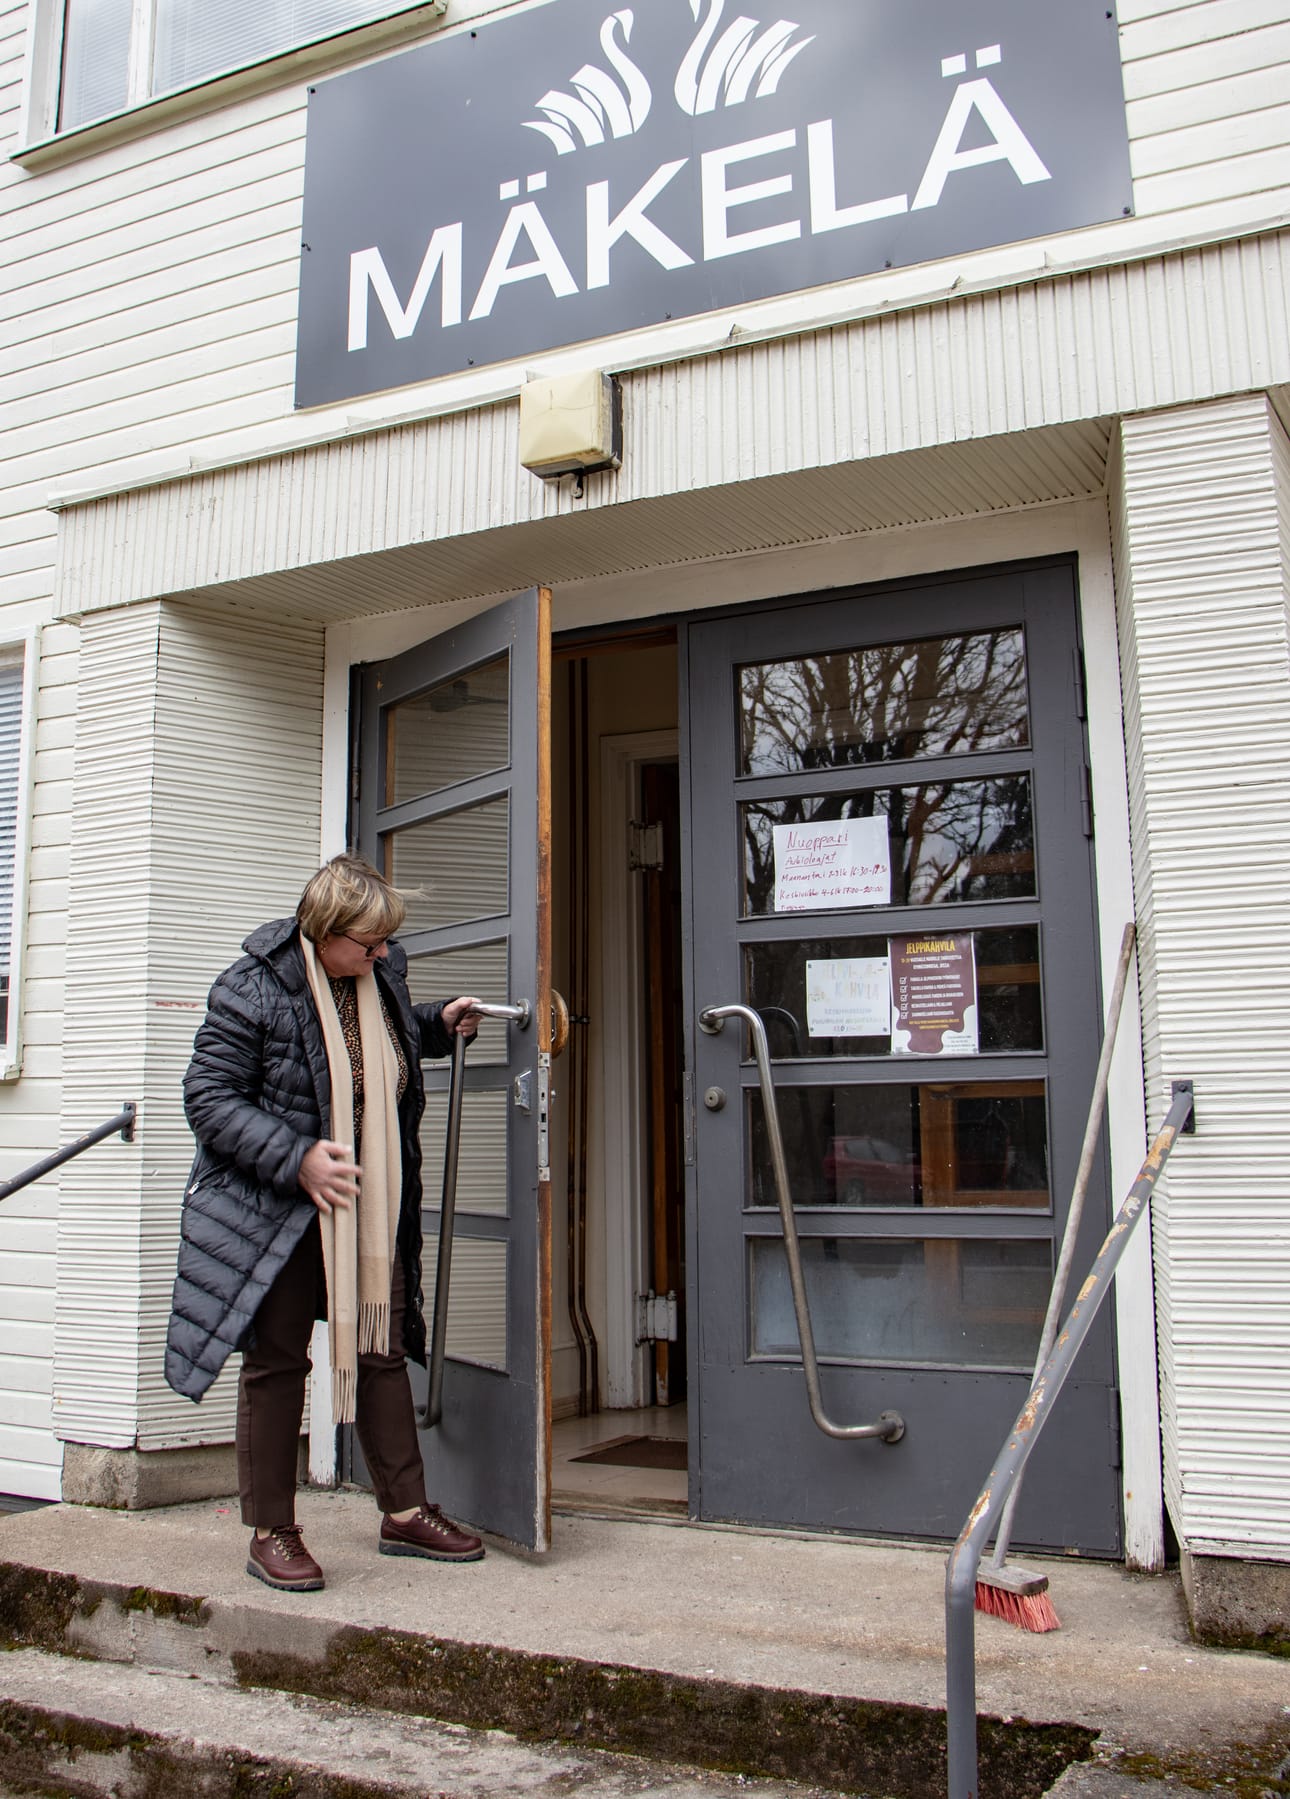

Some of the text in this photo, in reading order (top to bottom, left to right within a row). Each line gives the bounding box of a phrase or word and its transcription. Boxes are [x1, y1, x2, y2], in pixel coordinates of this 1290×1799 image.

[345, 44, 1051, 353] MÄKELÄ
[786, 830, 849, 851] Nuoppari
[905, 939, 956, 954] JELPPIKAHVILA
